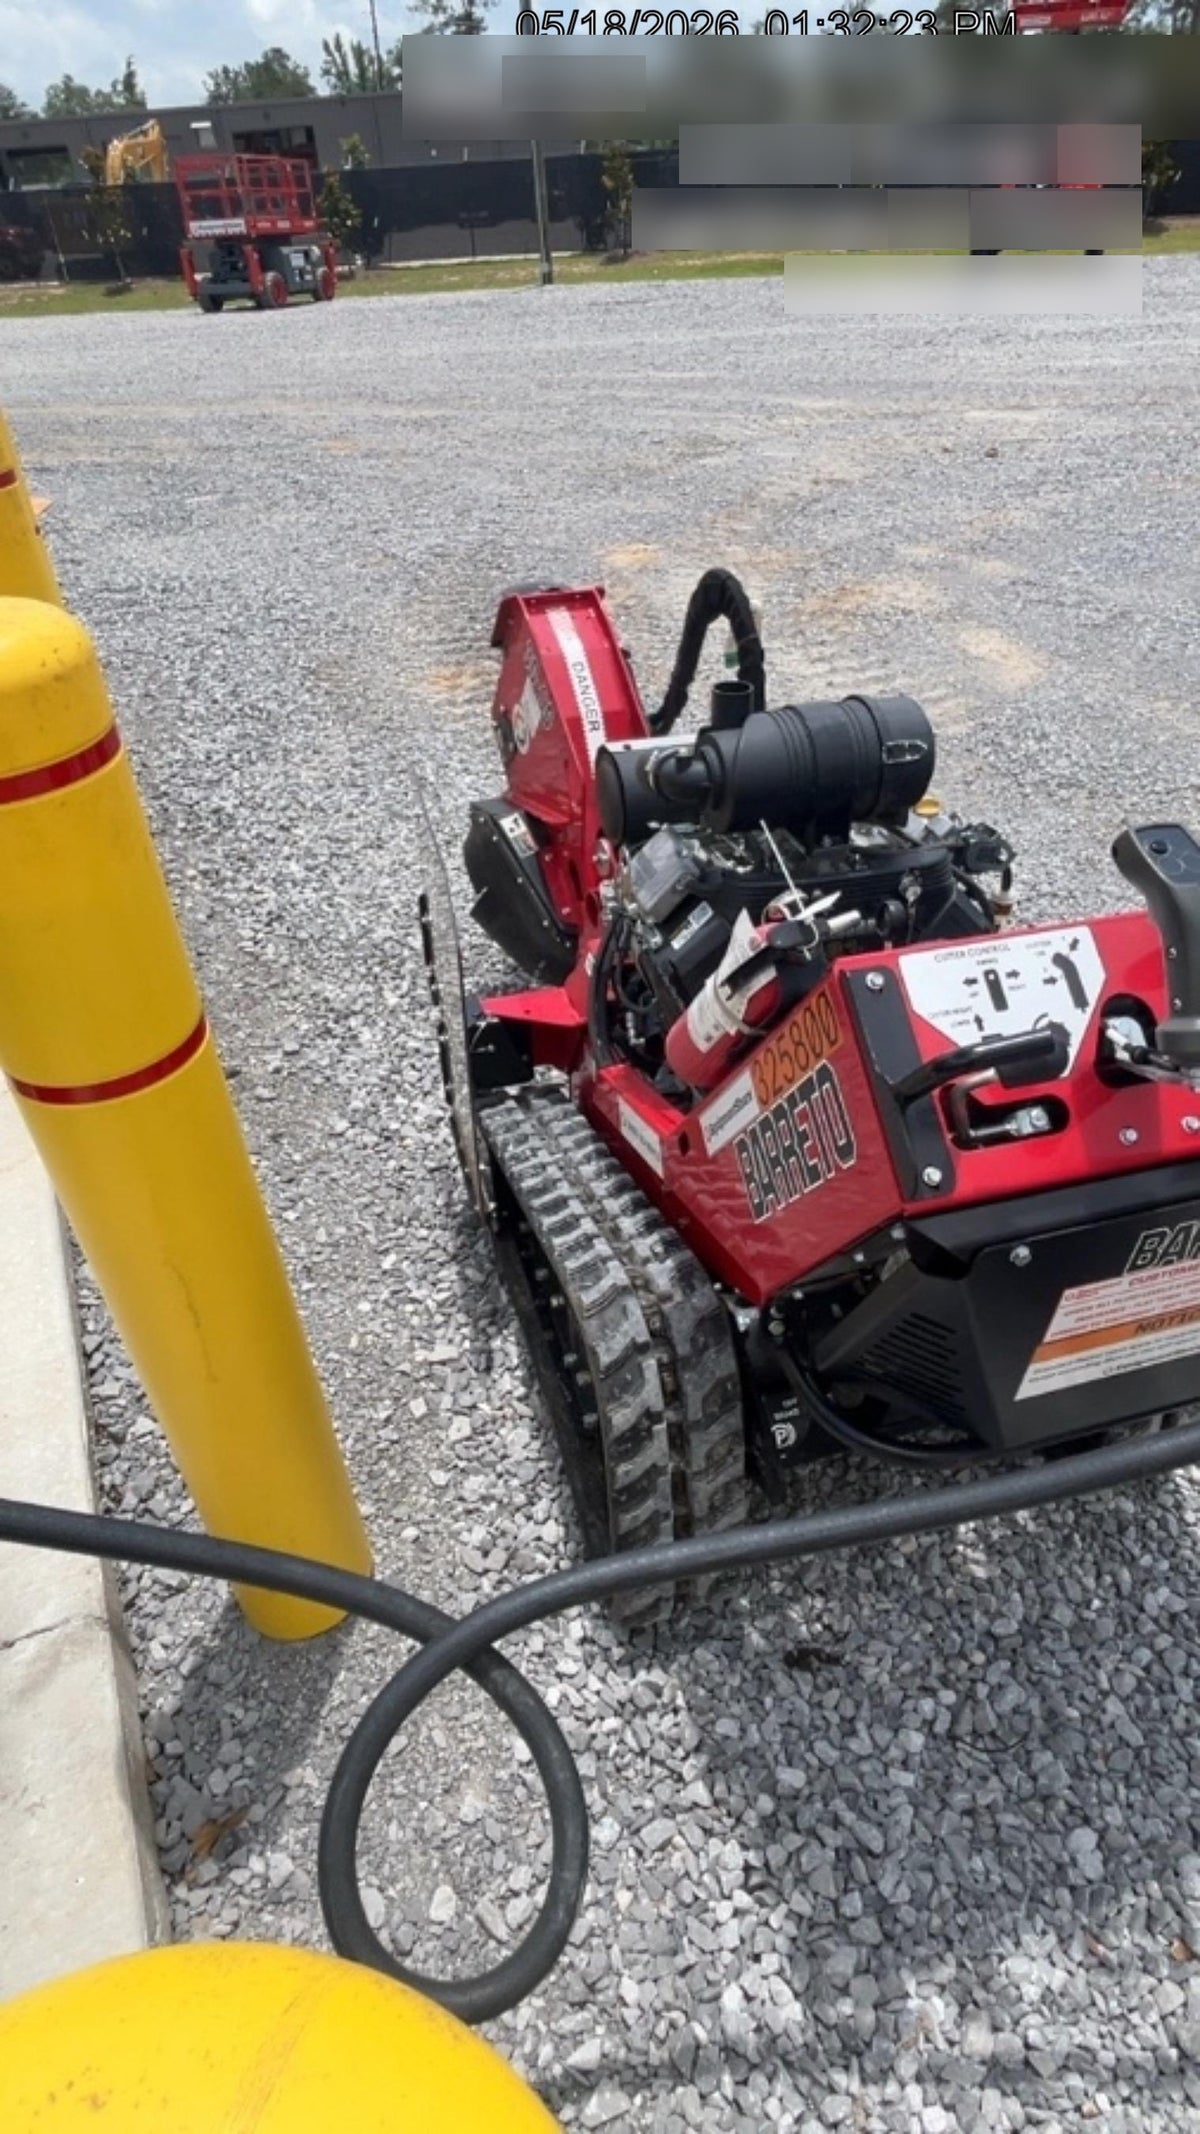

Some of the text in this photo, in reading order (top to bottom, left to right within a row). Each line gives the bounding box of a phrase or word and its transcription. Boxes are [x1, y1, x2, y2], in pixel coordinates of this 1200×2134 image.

[571, 660, 601, 733] DANGER
[753, 990, 838, 1106] 325800
[733, 1059, 857, 1224] BARRETO
[1124, 1220, 1200, 1275] BA
